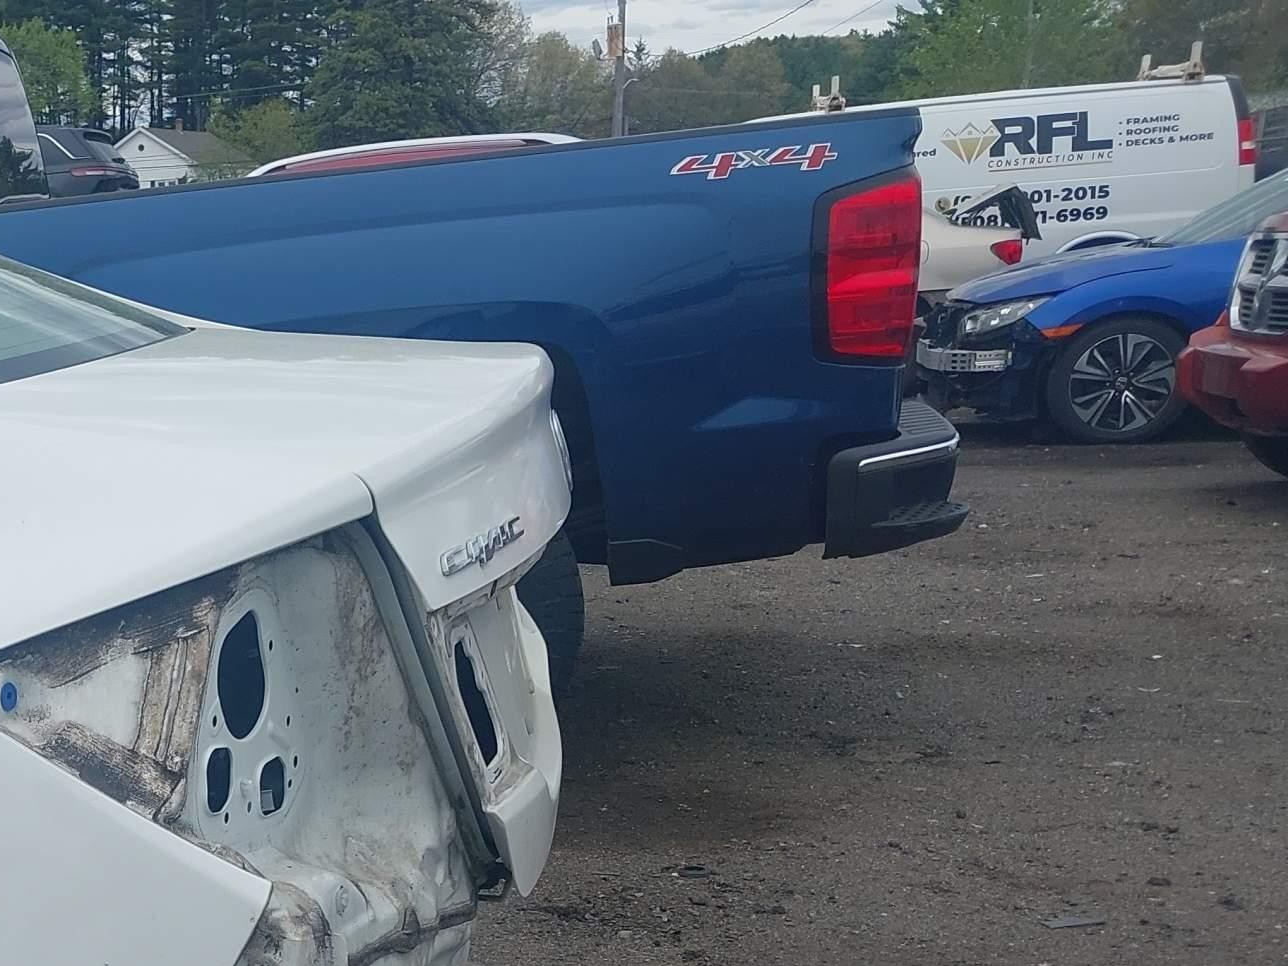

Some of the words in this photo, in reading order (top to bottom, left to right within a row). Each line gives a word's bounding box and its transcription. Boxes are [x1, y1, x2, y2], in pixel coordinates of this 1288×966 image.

[1126, 114, 1180, 125] FRAMING
[990, 111, 1113, 157] RFL
[1126, 125, 1179, 136] ROOFING
[1126, 137, 1164, 147] DECKS
[1179, 132, 1214, 142] MORE
[987, 154, 1083, 168] CONSTRUCTION
[1091, 151, 1113, 161] INC
[1023, 185, 1110, 204] 01-2015
[440, 516, 525, 577] CIVIC
